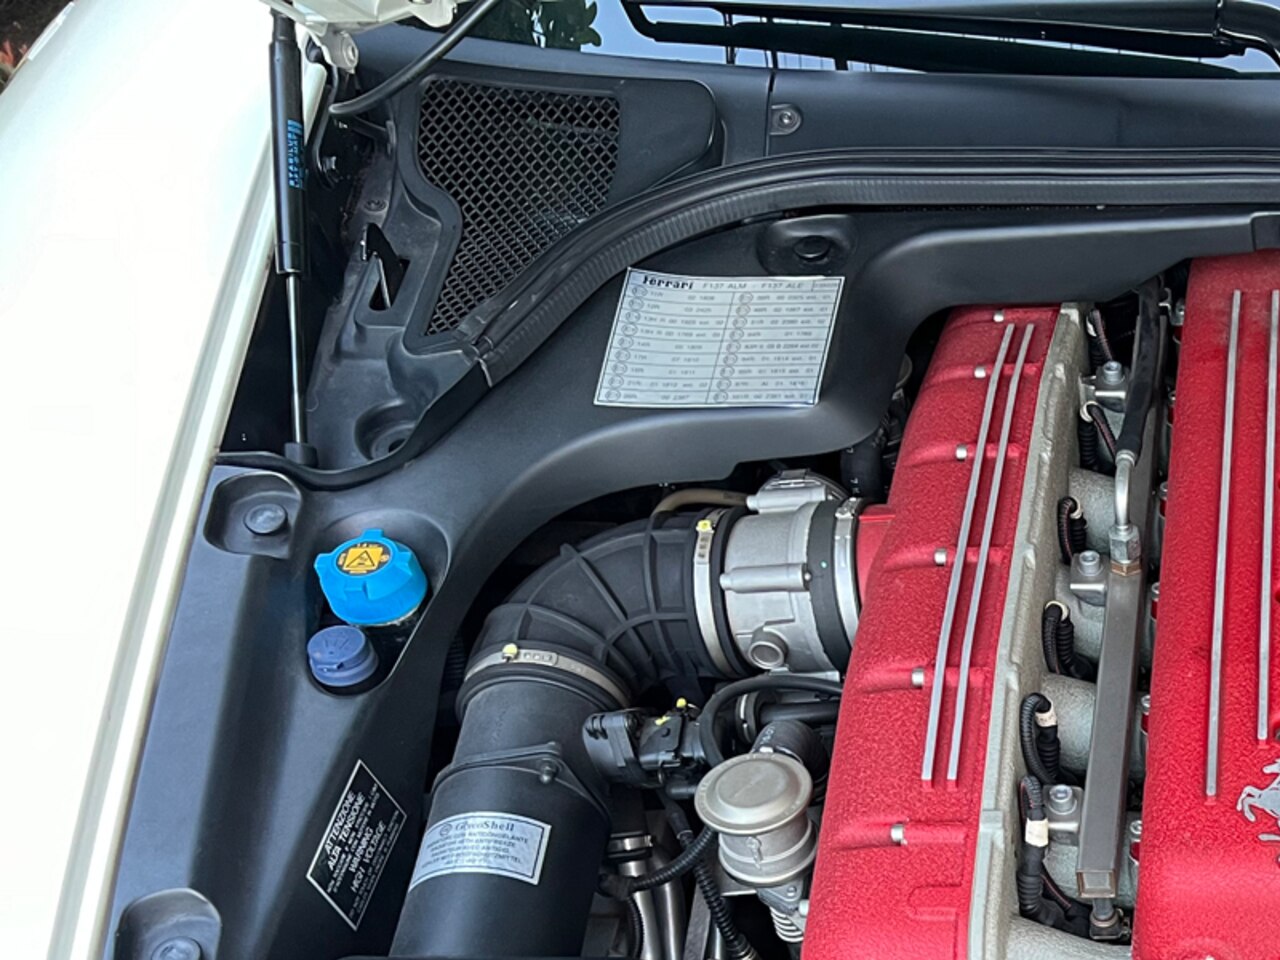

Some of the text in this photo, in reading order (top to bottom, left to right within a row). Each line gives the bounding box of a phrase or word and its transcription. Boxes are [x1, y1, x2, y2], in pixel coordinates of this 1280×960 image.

[642, 275, 694, 290] Ferrari
[325, 792, 354, 854] ATTENZIONE
[328, 793, 364, 870] ALTA TENSIONE
[349, 826, 373, 872] WARNING
[351, 821, 386, 892] HIGH VOLTAGE
